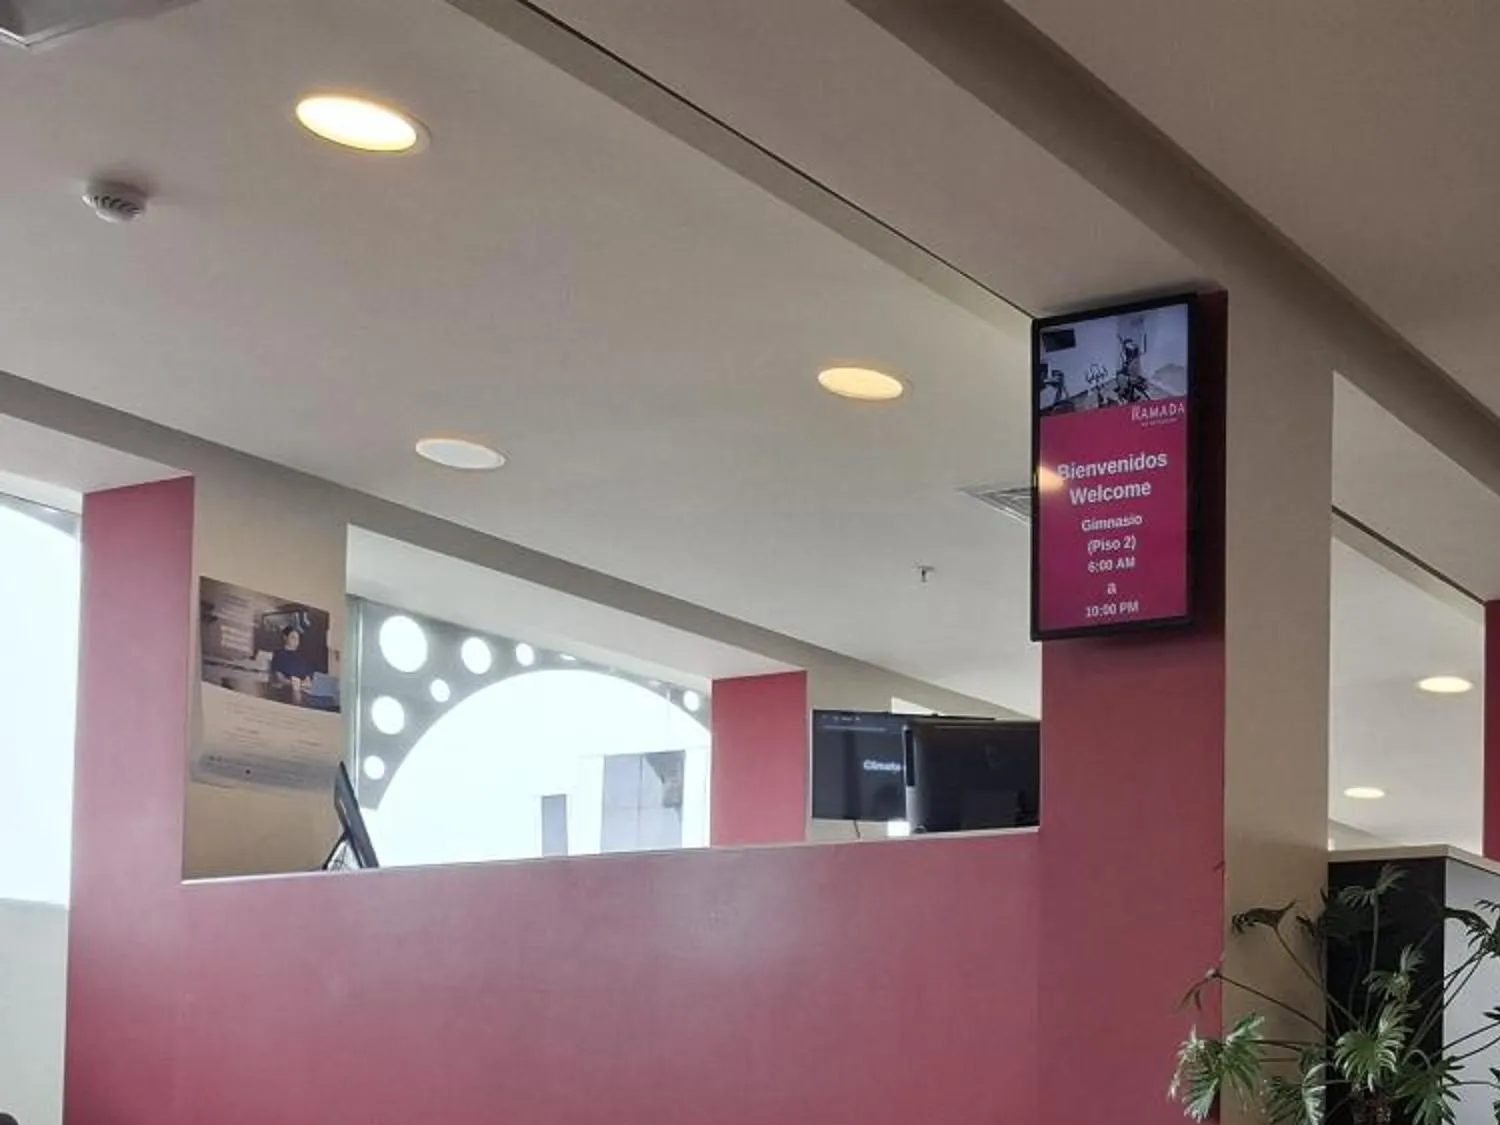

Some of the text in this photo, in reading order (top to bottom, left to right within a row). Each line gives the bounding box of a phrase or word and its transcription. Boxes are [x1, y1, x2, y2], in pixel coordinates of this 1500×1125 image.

[1131, 402, 1185, 421] RAMADA
[1057, 453, 1168, 480] Bienvenidos
[1069, 481, 1152, 505] Welcome
[1081, 514, 1143, 532] Gimnasio
[1087, 534, 1137, 556] (Piso 2)
[1116, 556, 1135, 569] AM
[1119, 600, 1139, 613] PM
